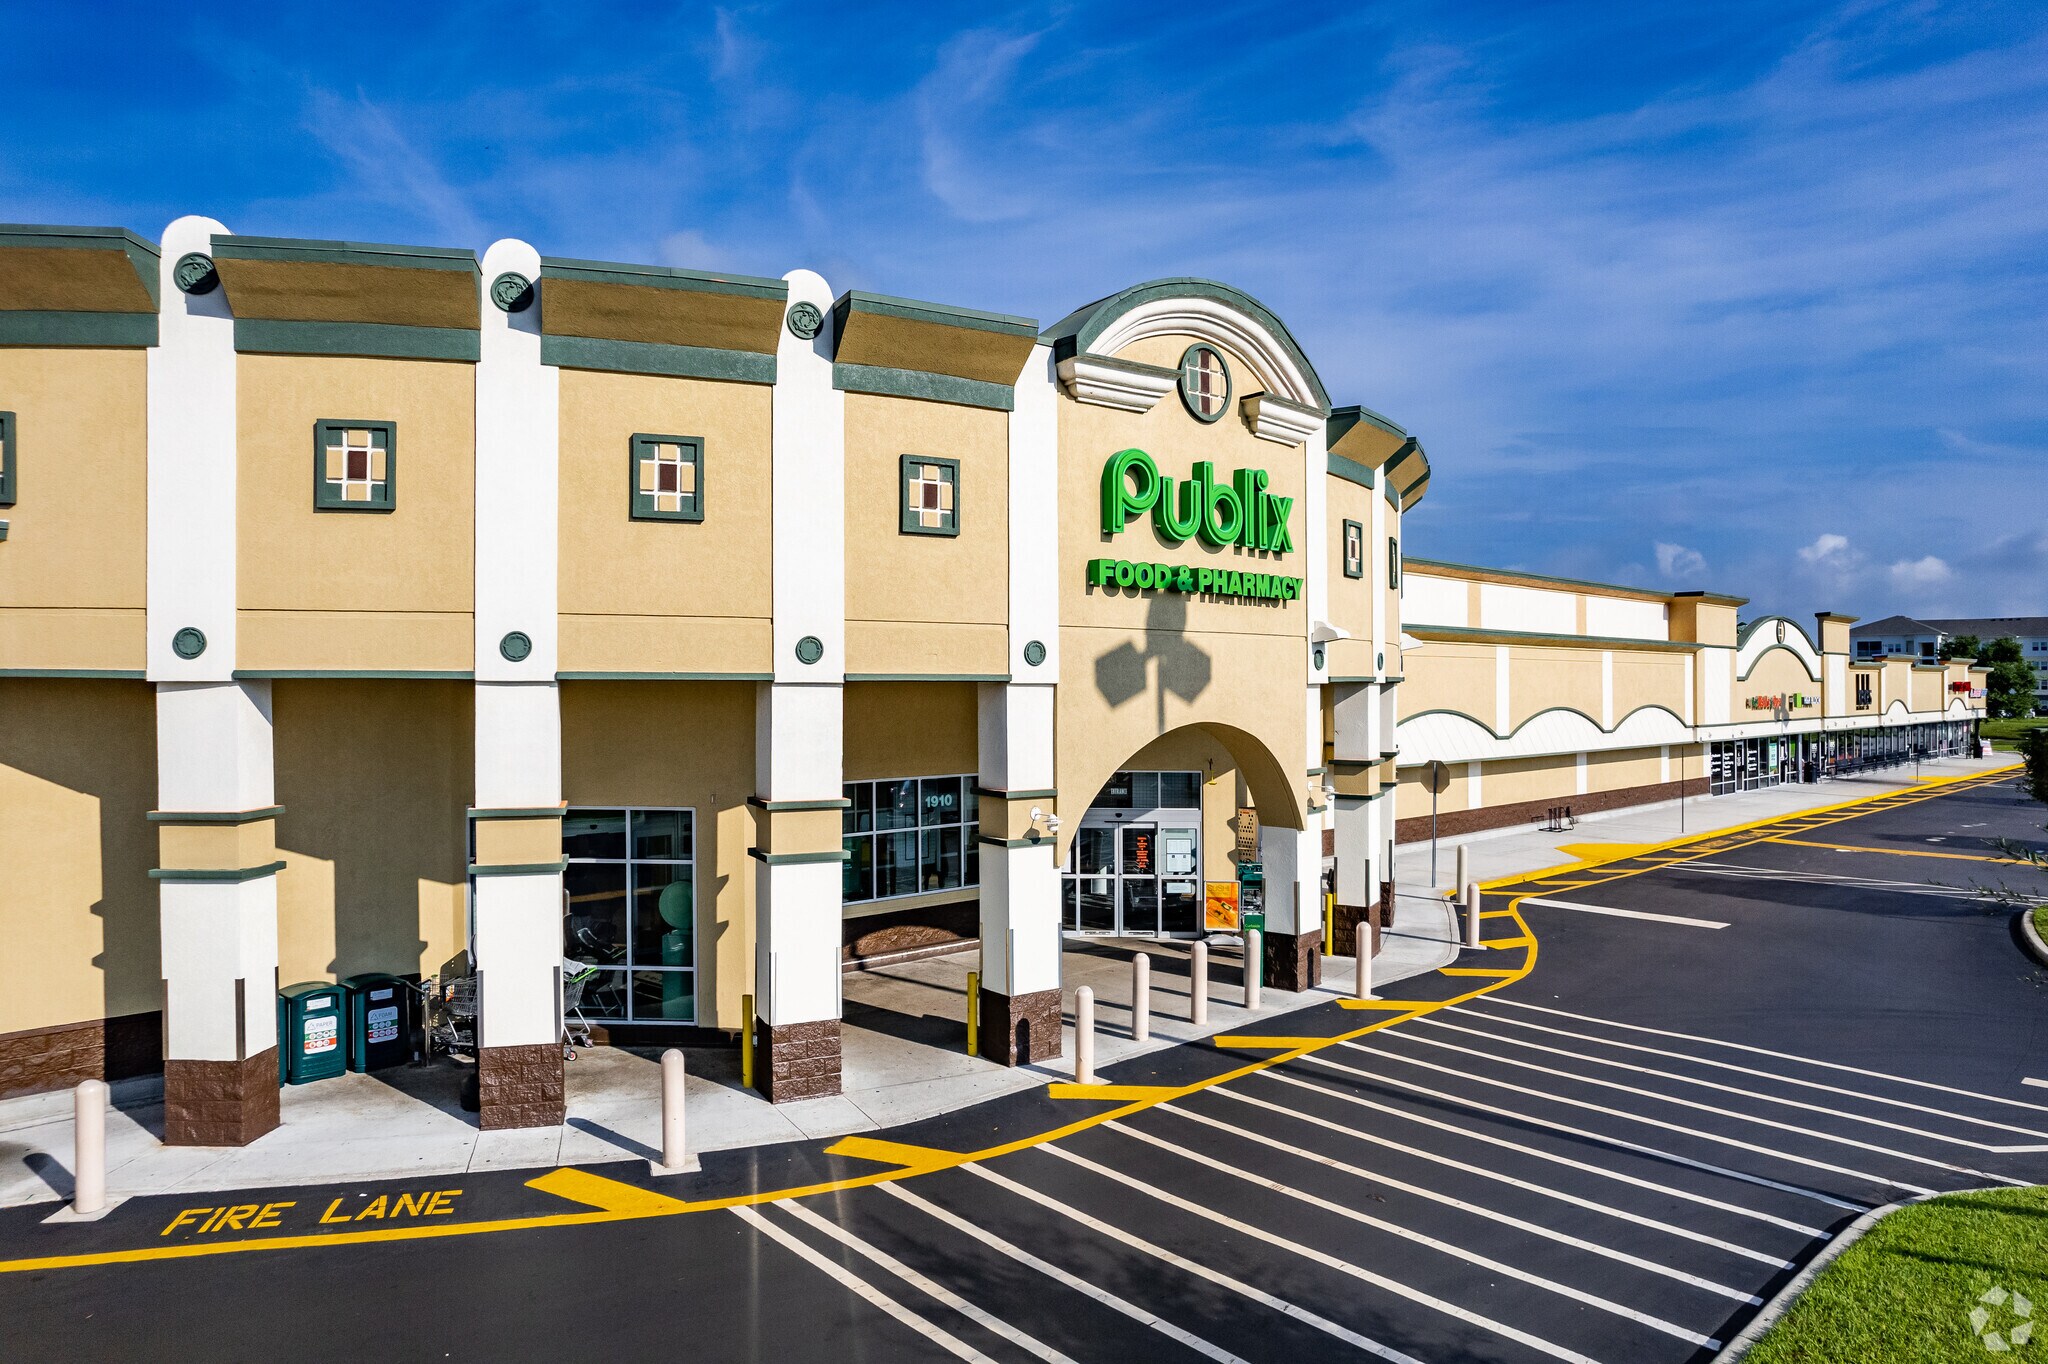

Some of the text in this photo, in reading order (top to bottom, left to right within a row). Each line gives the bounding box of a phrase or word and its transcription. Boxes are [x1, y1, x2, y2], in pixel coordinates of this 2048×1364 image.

[1103, 448, 1294, 553] Publix
[1088, 559, 1304, 600] FOOD & PHARMACY
[925, 794, 953, 808] 1910
[1206, 884, 1230, 892] SUSHI
[378, 1011, 393, 1019] FOAM
[316, 1020, 333, 1028] PAPER
[161, 1189, 463, 1237] FIRE LANE
